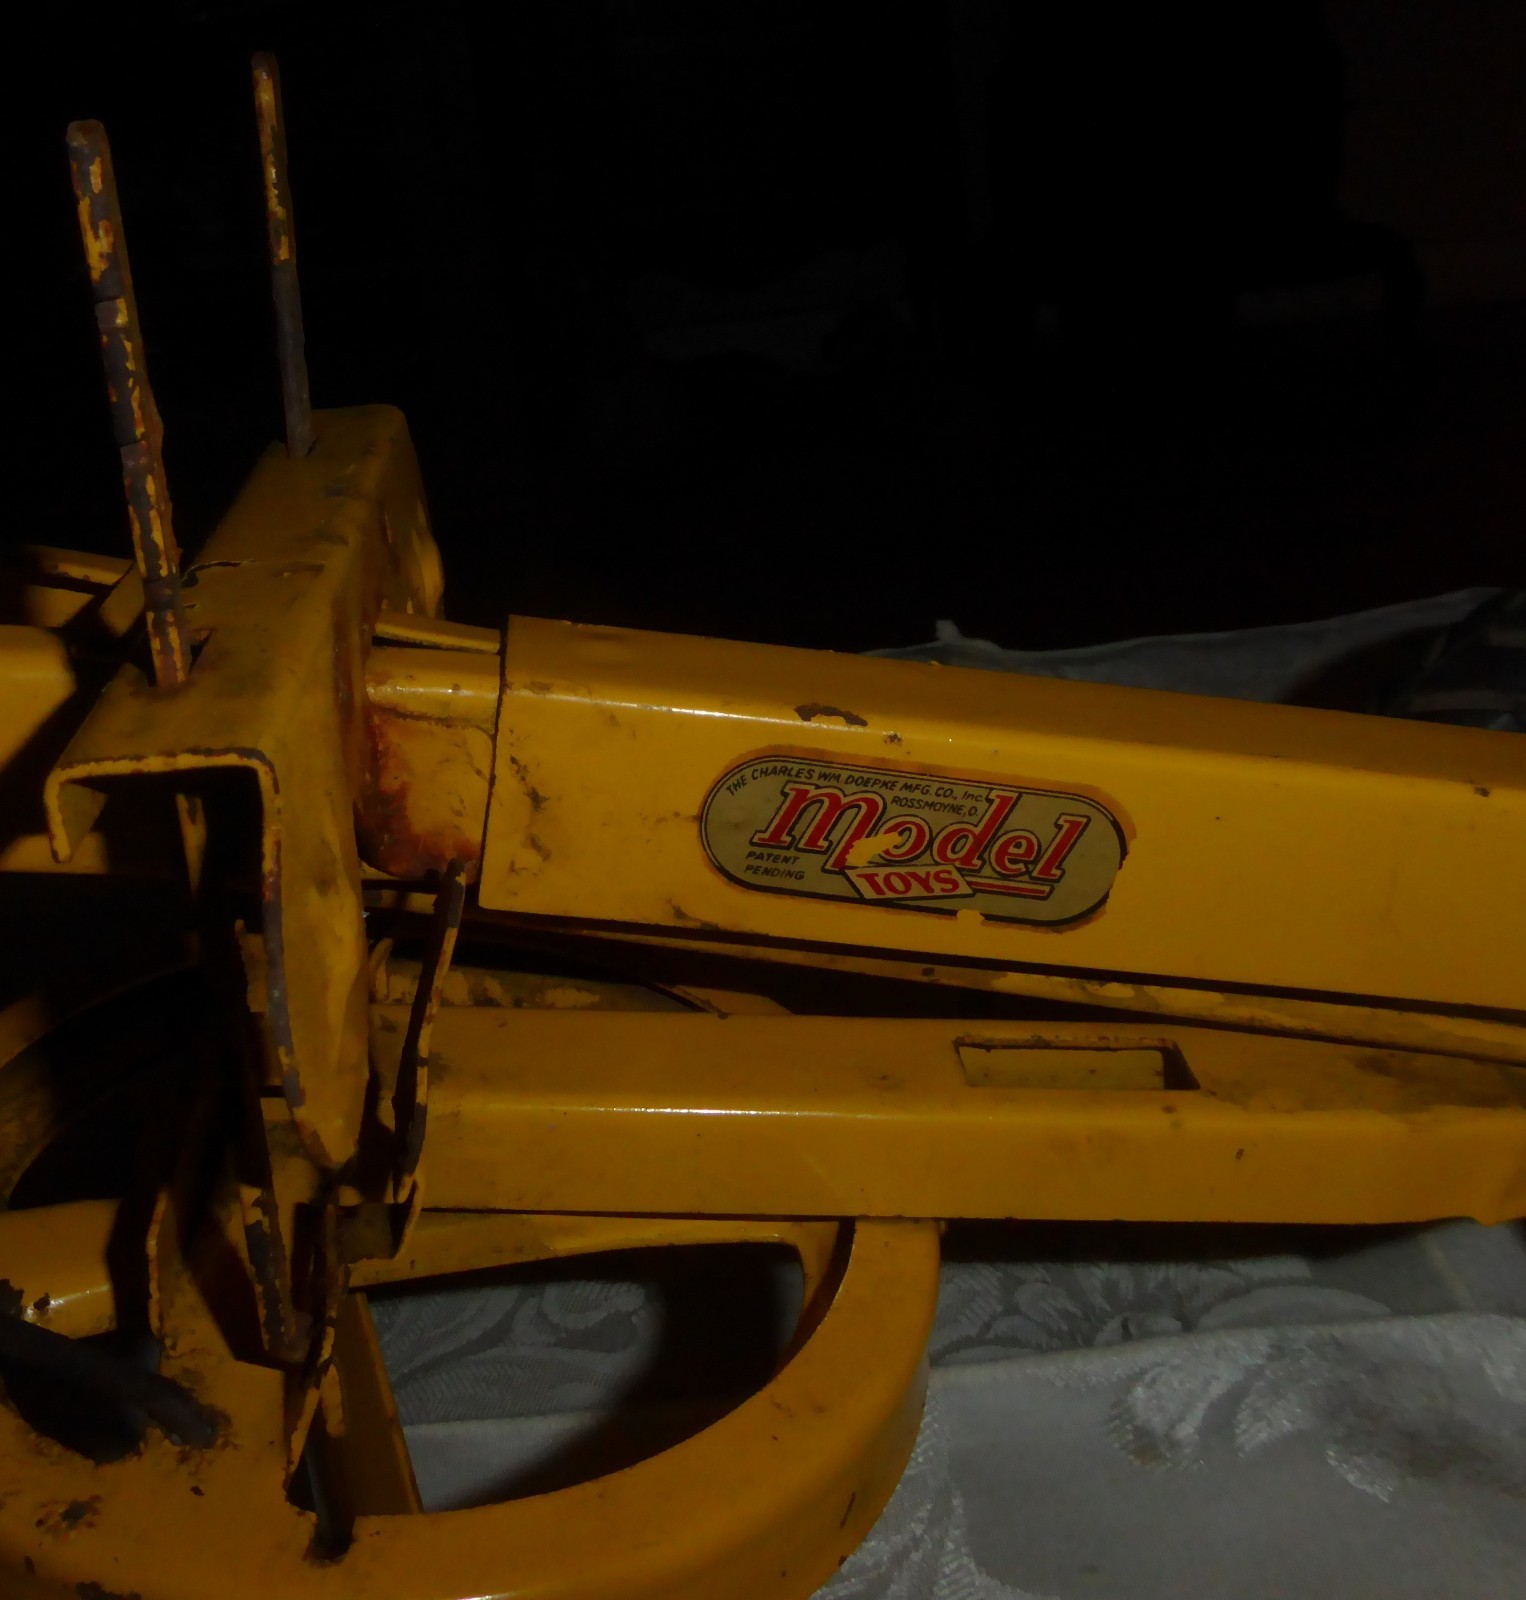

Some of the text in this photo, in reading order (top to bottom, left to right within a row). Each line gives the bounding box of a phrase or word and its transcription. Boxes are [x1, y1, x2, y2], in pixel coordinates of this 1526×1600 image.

[725, 774, 748, 797] THE
[751, 765, 815, 780] CHARLES
[845, 774, 899, 791] DOEPKE
[890, 796, 966, 817] ROSSMOYNE,
[745, 850, 800, 865] PATENT
[744, 864, 806, 880] PENDING
[856, 868, 960, 897] TOYS
